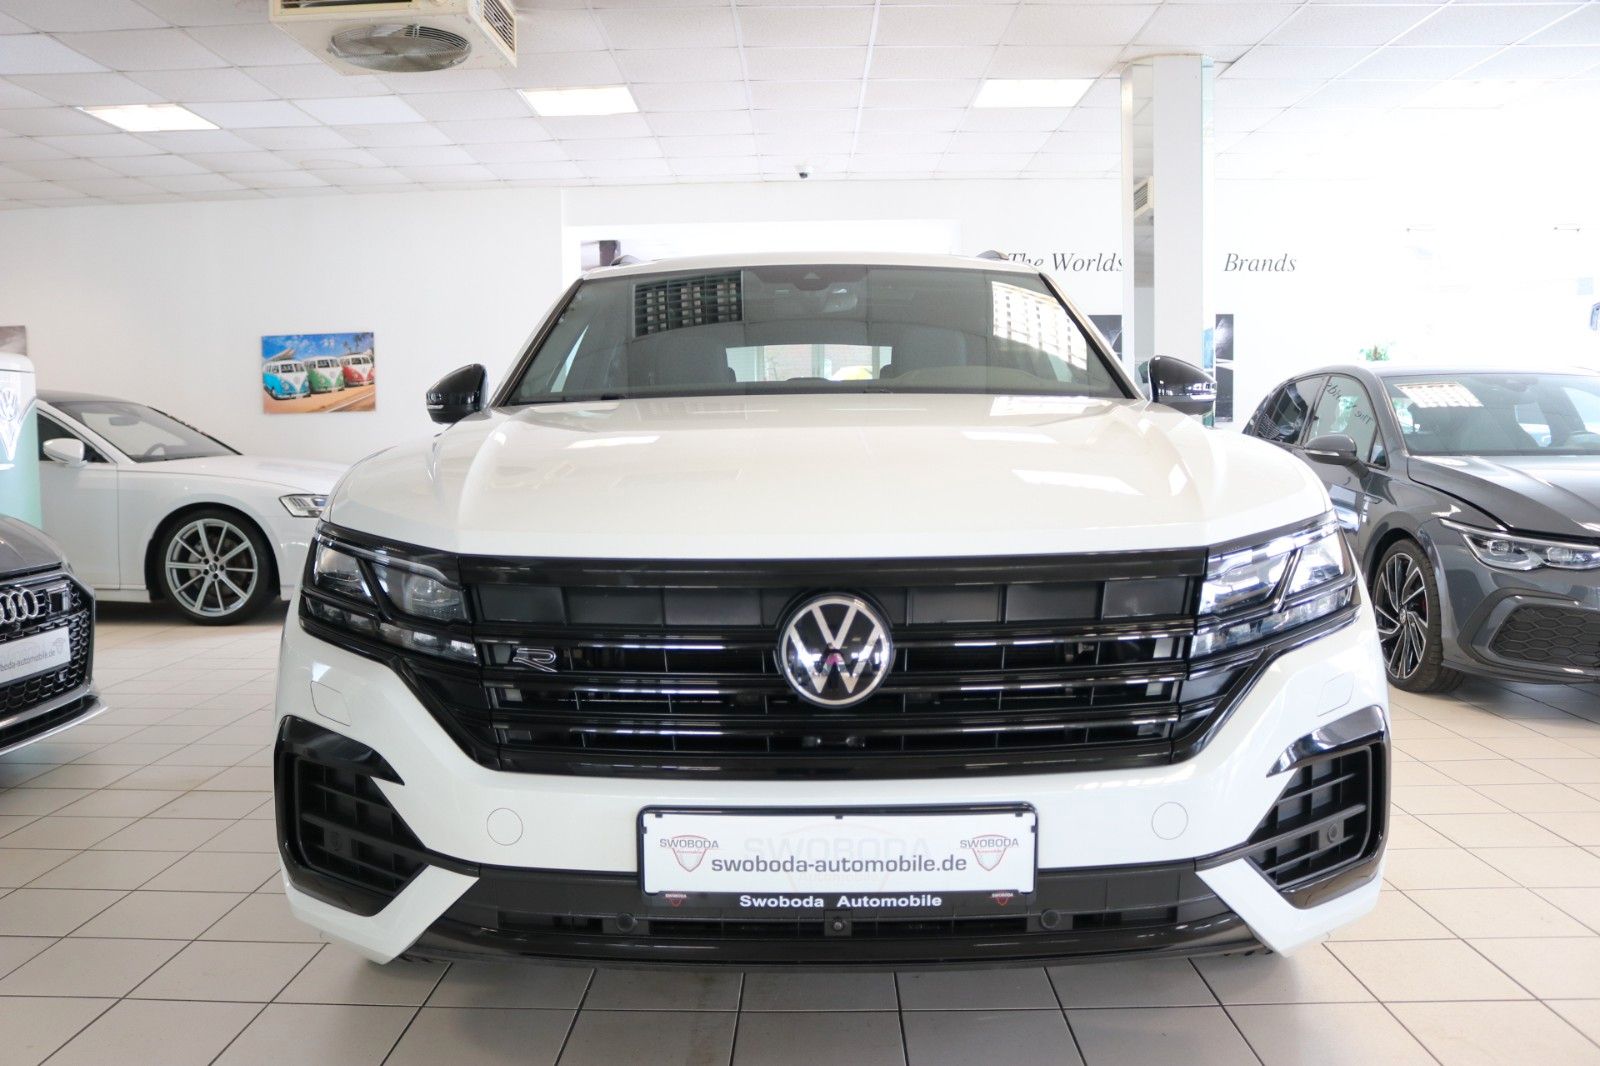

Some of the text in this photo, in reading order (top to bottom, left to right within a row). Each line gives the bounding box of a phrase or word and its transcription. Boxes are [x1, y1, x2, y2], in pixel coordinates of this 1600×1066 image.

[1224, 252, 1297, 272] Brands
[659, 838, 719, 849] SWOBODA
[960, 838, 1019, 849] SWOBODA
[711, 854, 967, 873] swoboda-automobile.de
[739, 894, 942, 908] Swoboda Automobile
